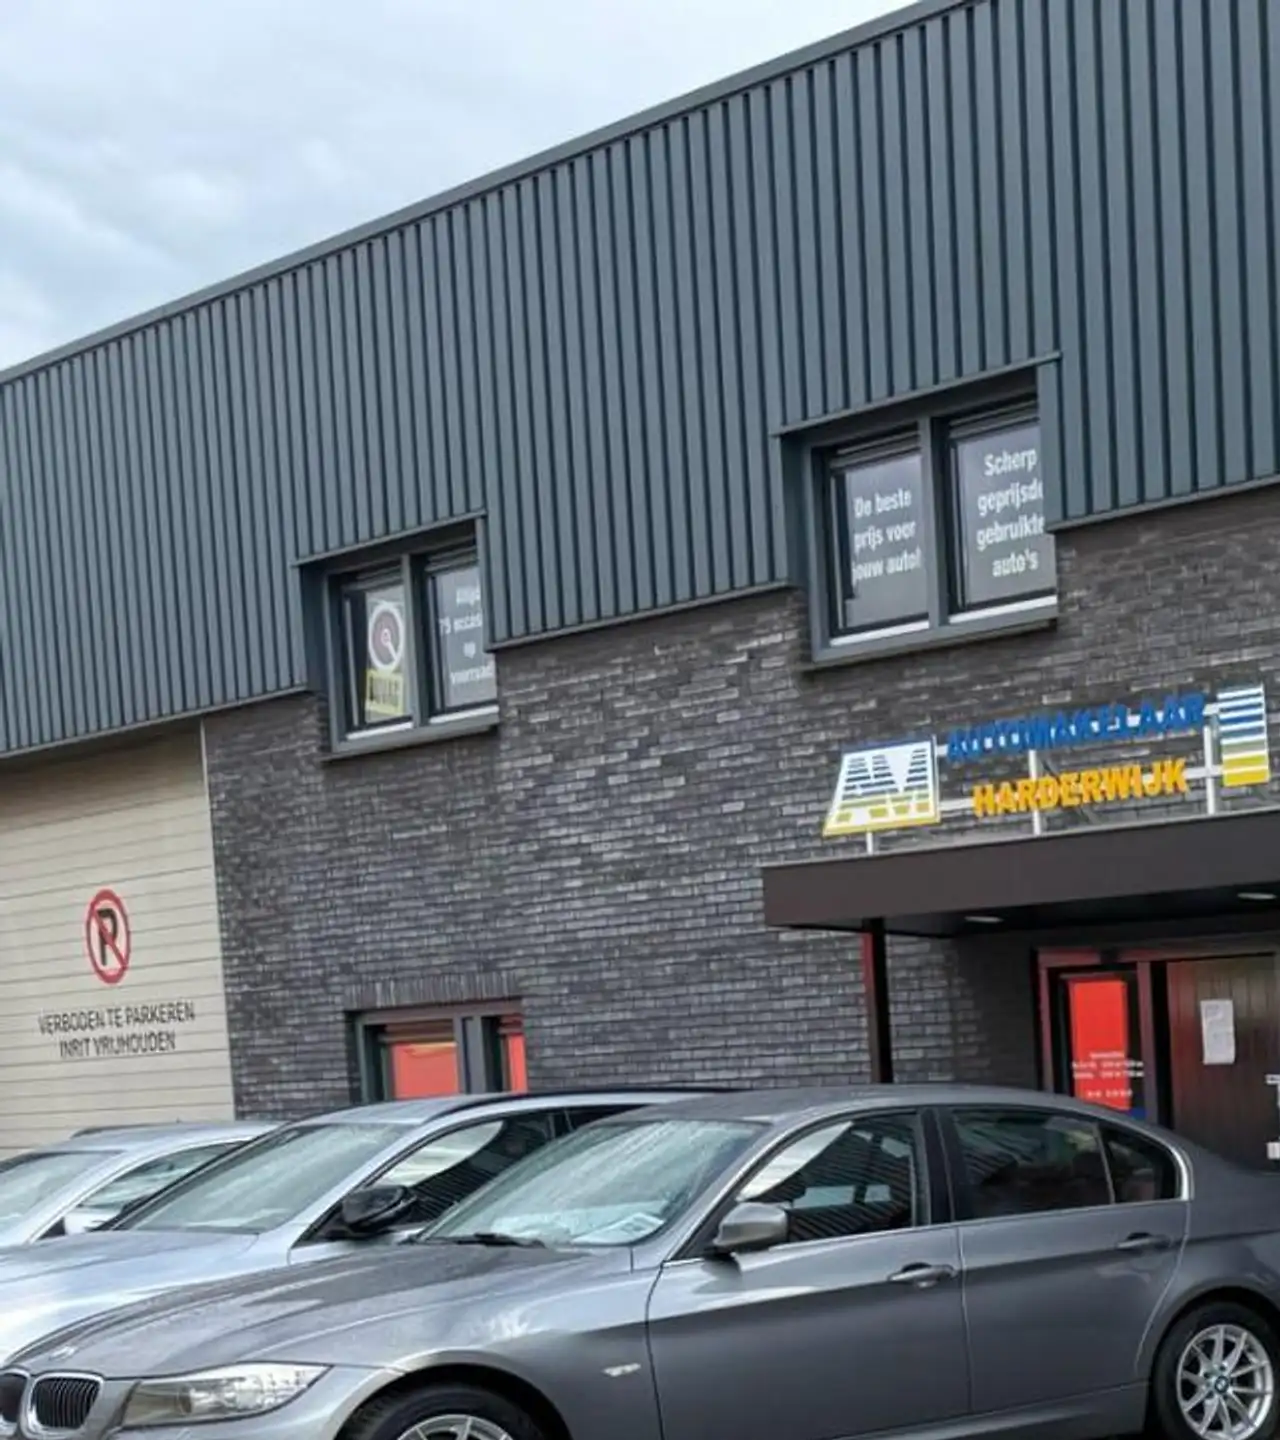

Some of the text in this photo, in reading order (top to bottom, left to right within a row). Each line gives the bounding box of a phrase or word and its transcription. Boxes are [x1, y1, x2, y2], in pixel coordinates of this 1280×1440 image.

[984, 448, 1038, 477] Scherp
[992, 548, 1039, 578] auto's
[946, 692, 1205, 763] AUTOMAKELAAR
[972, 757, 1190, 818] HARDERWIJK
[125, 1001, 196, 1025] PARKEREN
